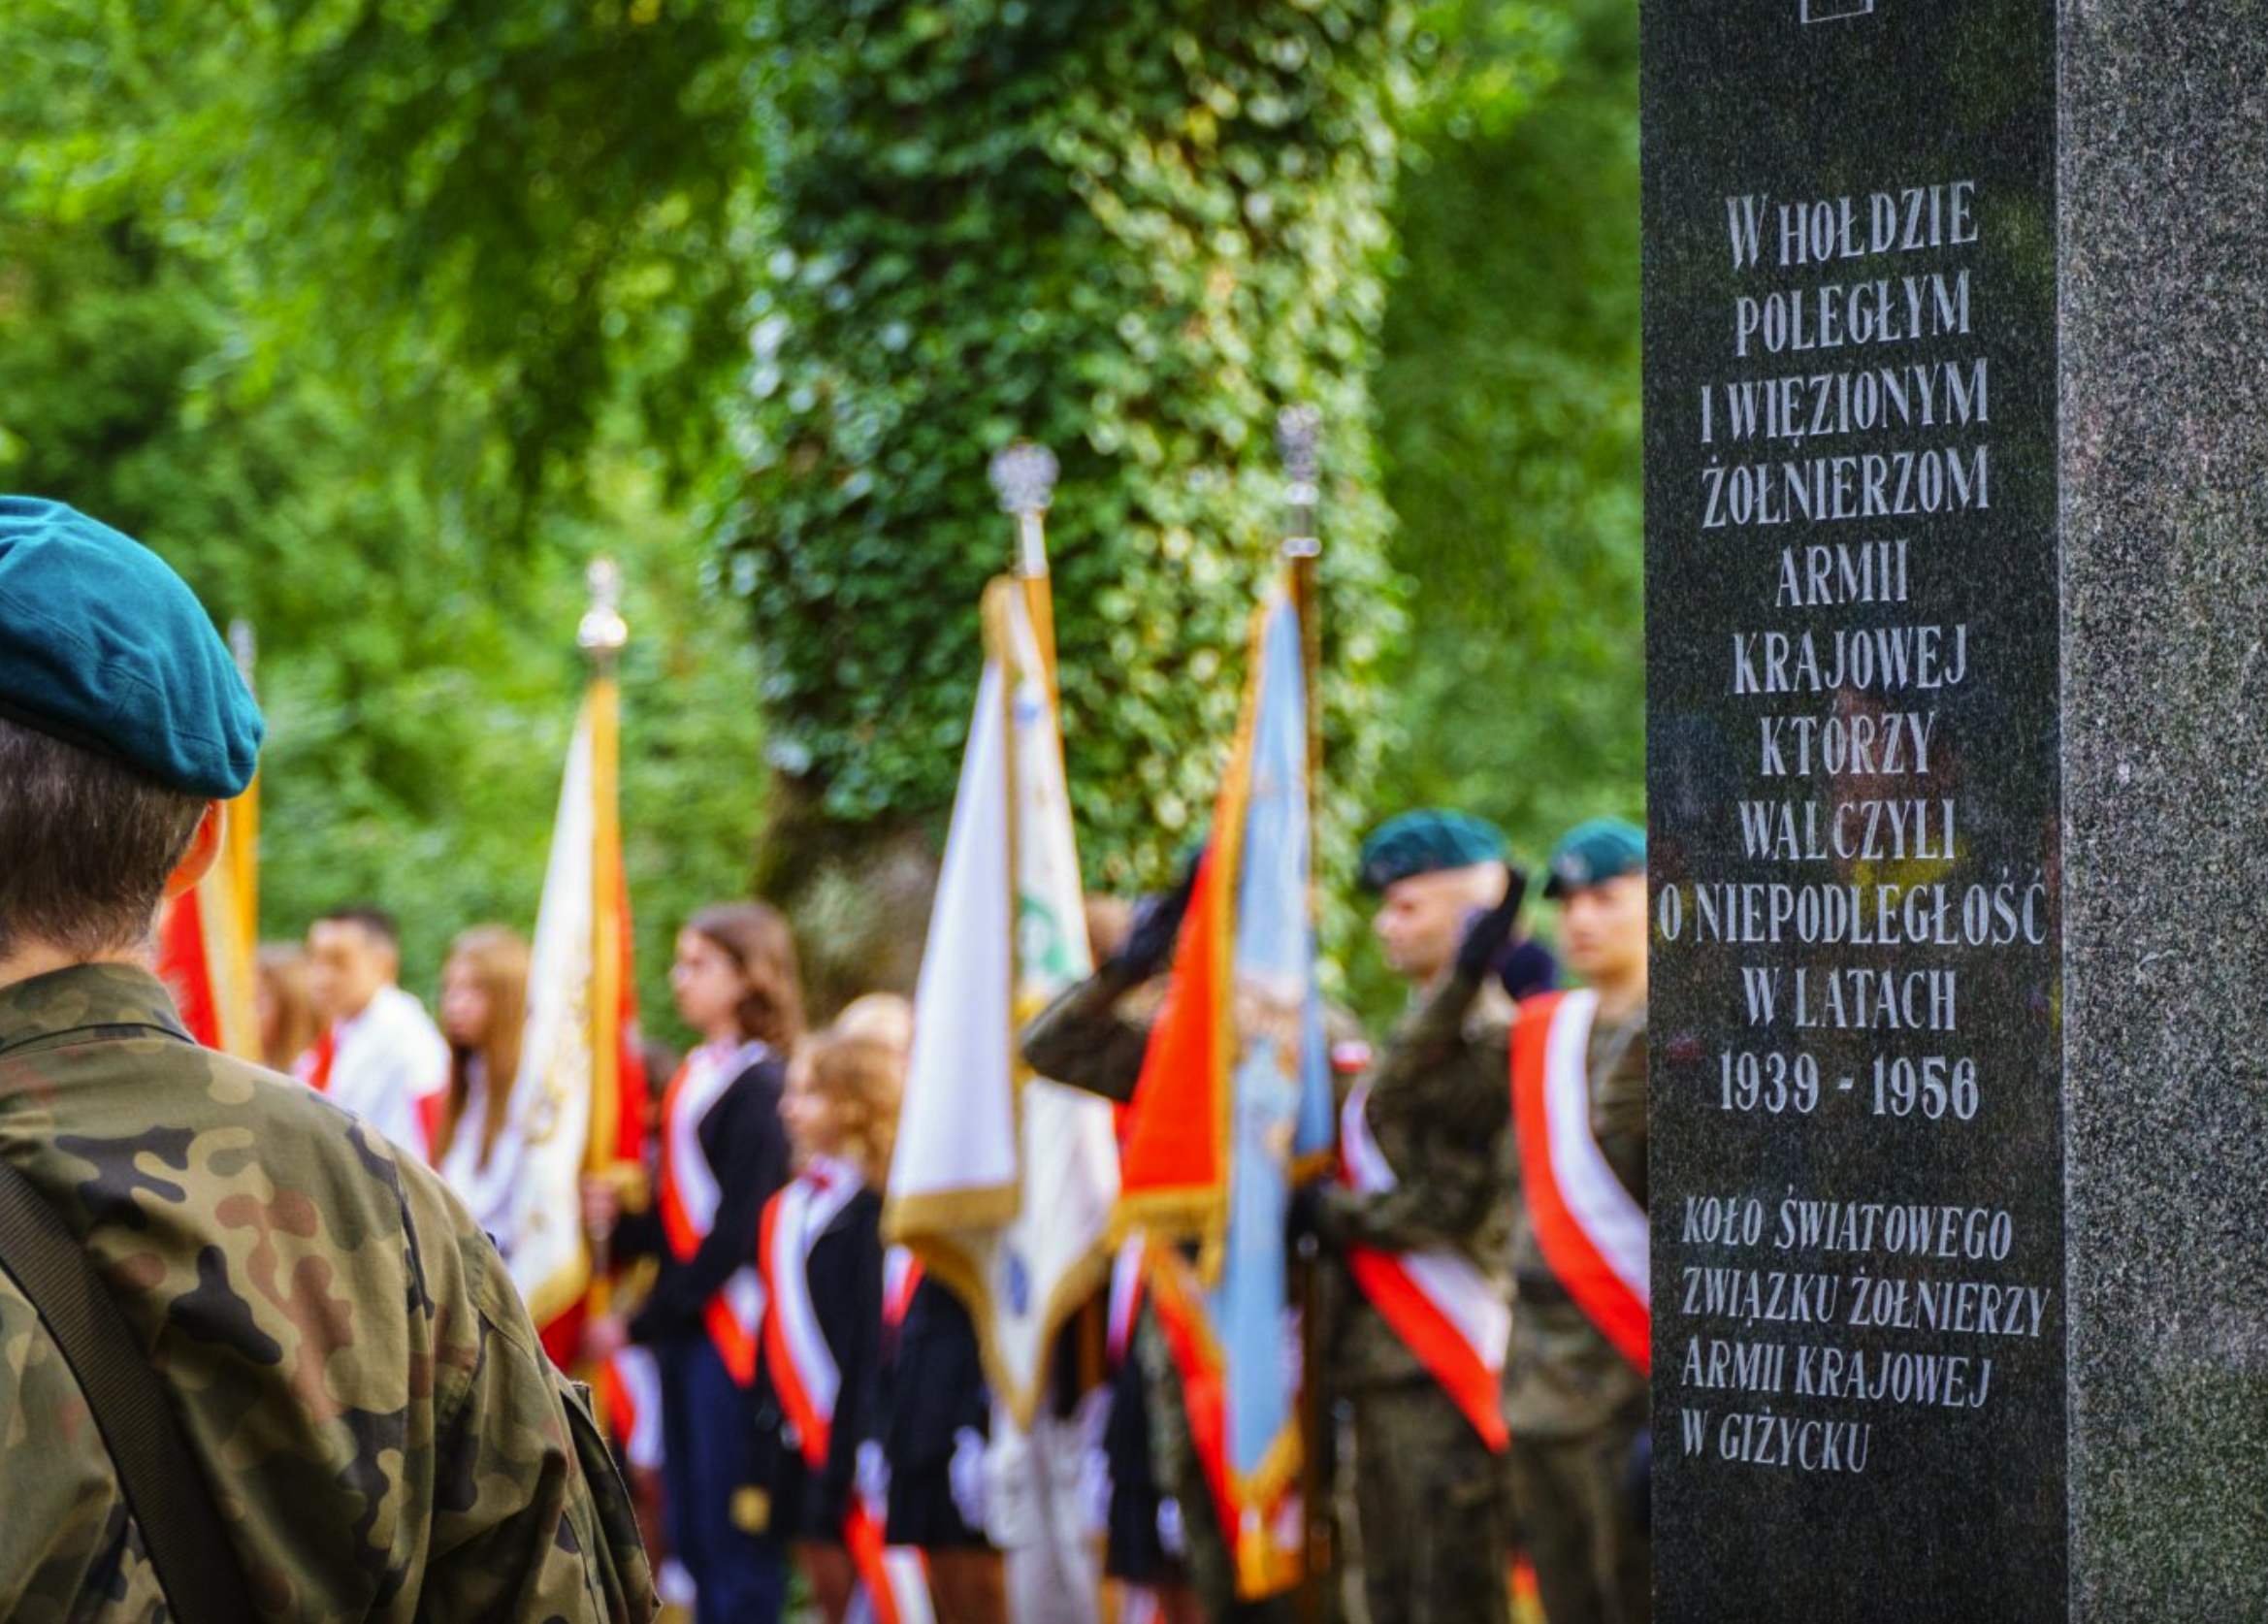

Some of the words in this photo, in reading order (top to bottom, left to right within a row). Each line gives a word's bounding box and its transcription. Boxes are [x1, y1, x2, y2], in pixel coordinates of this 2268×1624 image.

[1725, 194, 1769, 271] W
[1778, 180, 1978, 266] HOŁDZIE
[1736, 270, 1970, 356] POLEGŁYM
[1701, 385, 1712, 442] I
[1728, 358, 1988, 447] WIĘZIONYM
[1702, 444, 1990, 528] ŻOŁNIERZOM
[1776, 539, 1907, 606] ARMII
[1733, 624, 1967, 694] KRAJOWEJ
[1739, 799, 1955, 861] WALCZYLI
[1659, 883, 1681, 941] O
[1696, 866, 2047, 946] NIEPODLEGŁOŚĆ
[1741, 967, 1779, 1026] W
[1796, 967, 1957, 1030] LATACH
[1721, 1049, 1819, 1113] 1939
[1838, 1078, 1853, 1089] -
[1873, 1053, 1979, 1120] 1956
[1682, 1195, 1763, 1246] KOŁO
[1775, 1184, 2012, 1261] ŚWIATOWEGO
[1682, 1266, 1838, 1326] ZWIĄZKU
[1848, 1266, 2051, 1337] ŻOŁNIERZY
[1681, 1335, 1784, 1392] ARMII
[1795, 1345, 1992, 1408] KRAJOWEJ
[1681, 1408, 1708, 1456] W
[1719, 1407, 1870, 1473] GIŻYCKU
